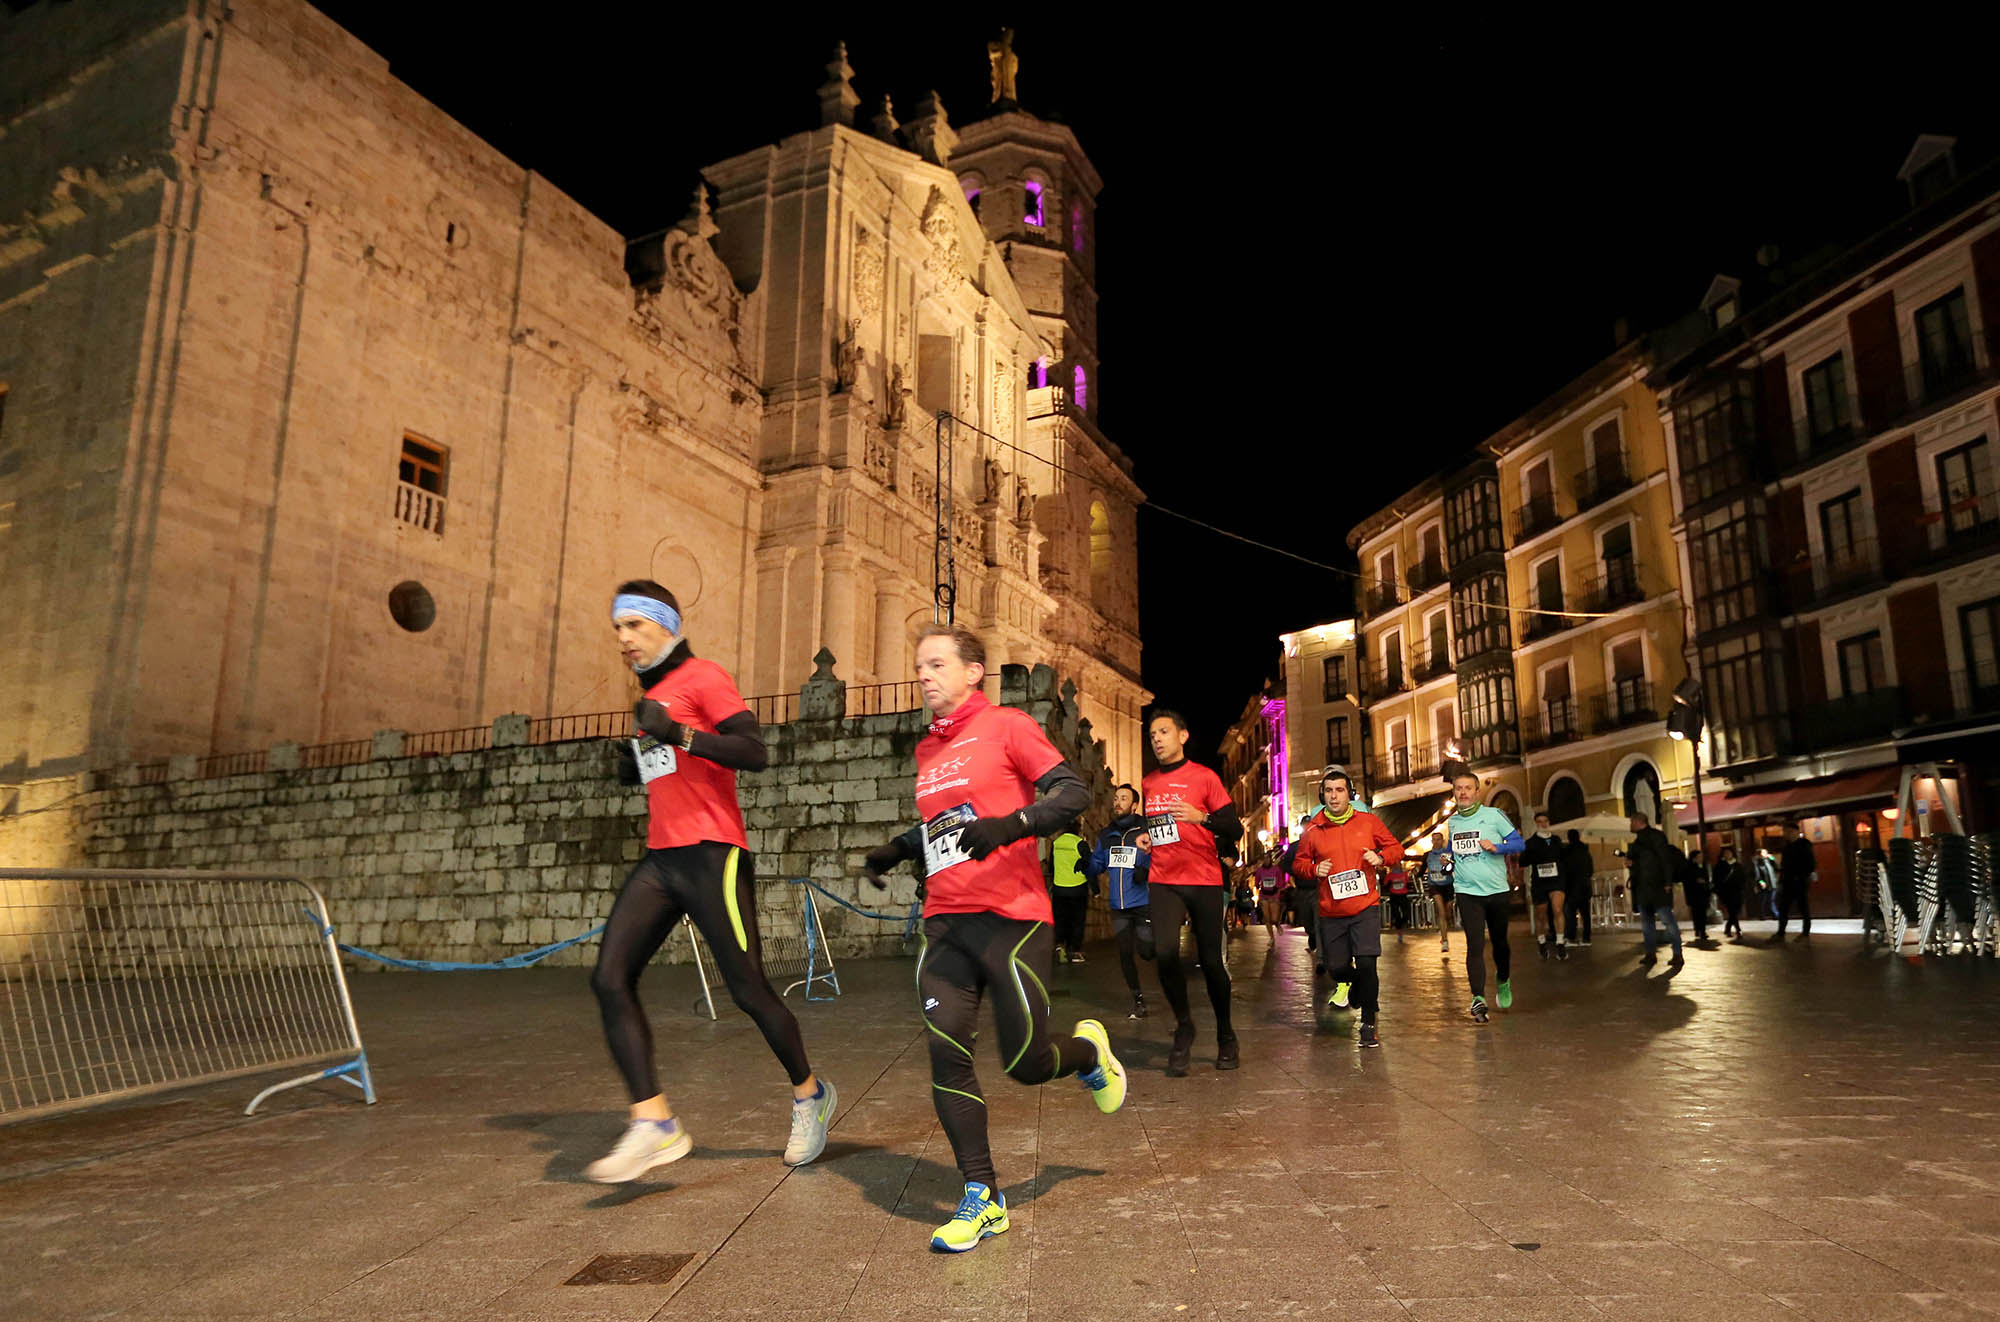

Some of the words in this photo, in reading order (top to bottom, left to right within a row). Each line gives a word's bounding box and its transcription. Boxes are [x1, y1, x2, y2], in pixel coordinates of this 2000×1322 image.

[1456, 839, 1476, 849] 1501
[1113, 854, 1128, 863] 780
[1338, 880, 1359, 893] 783
